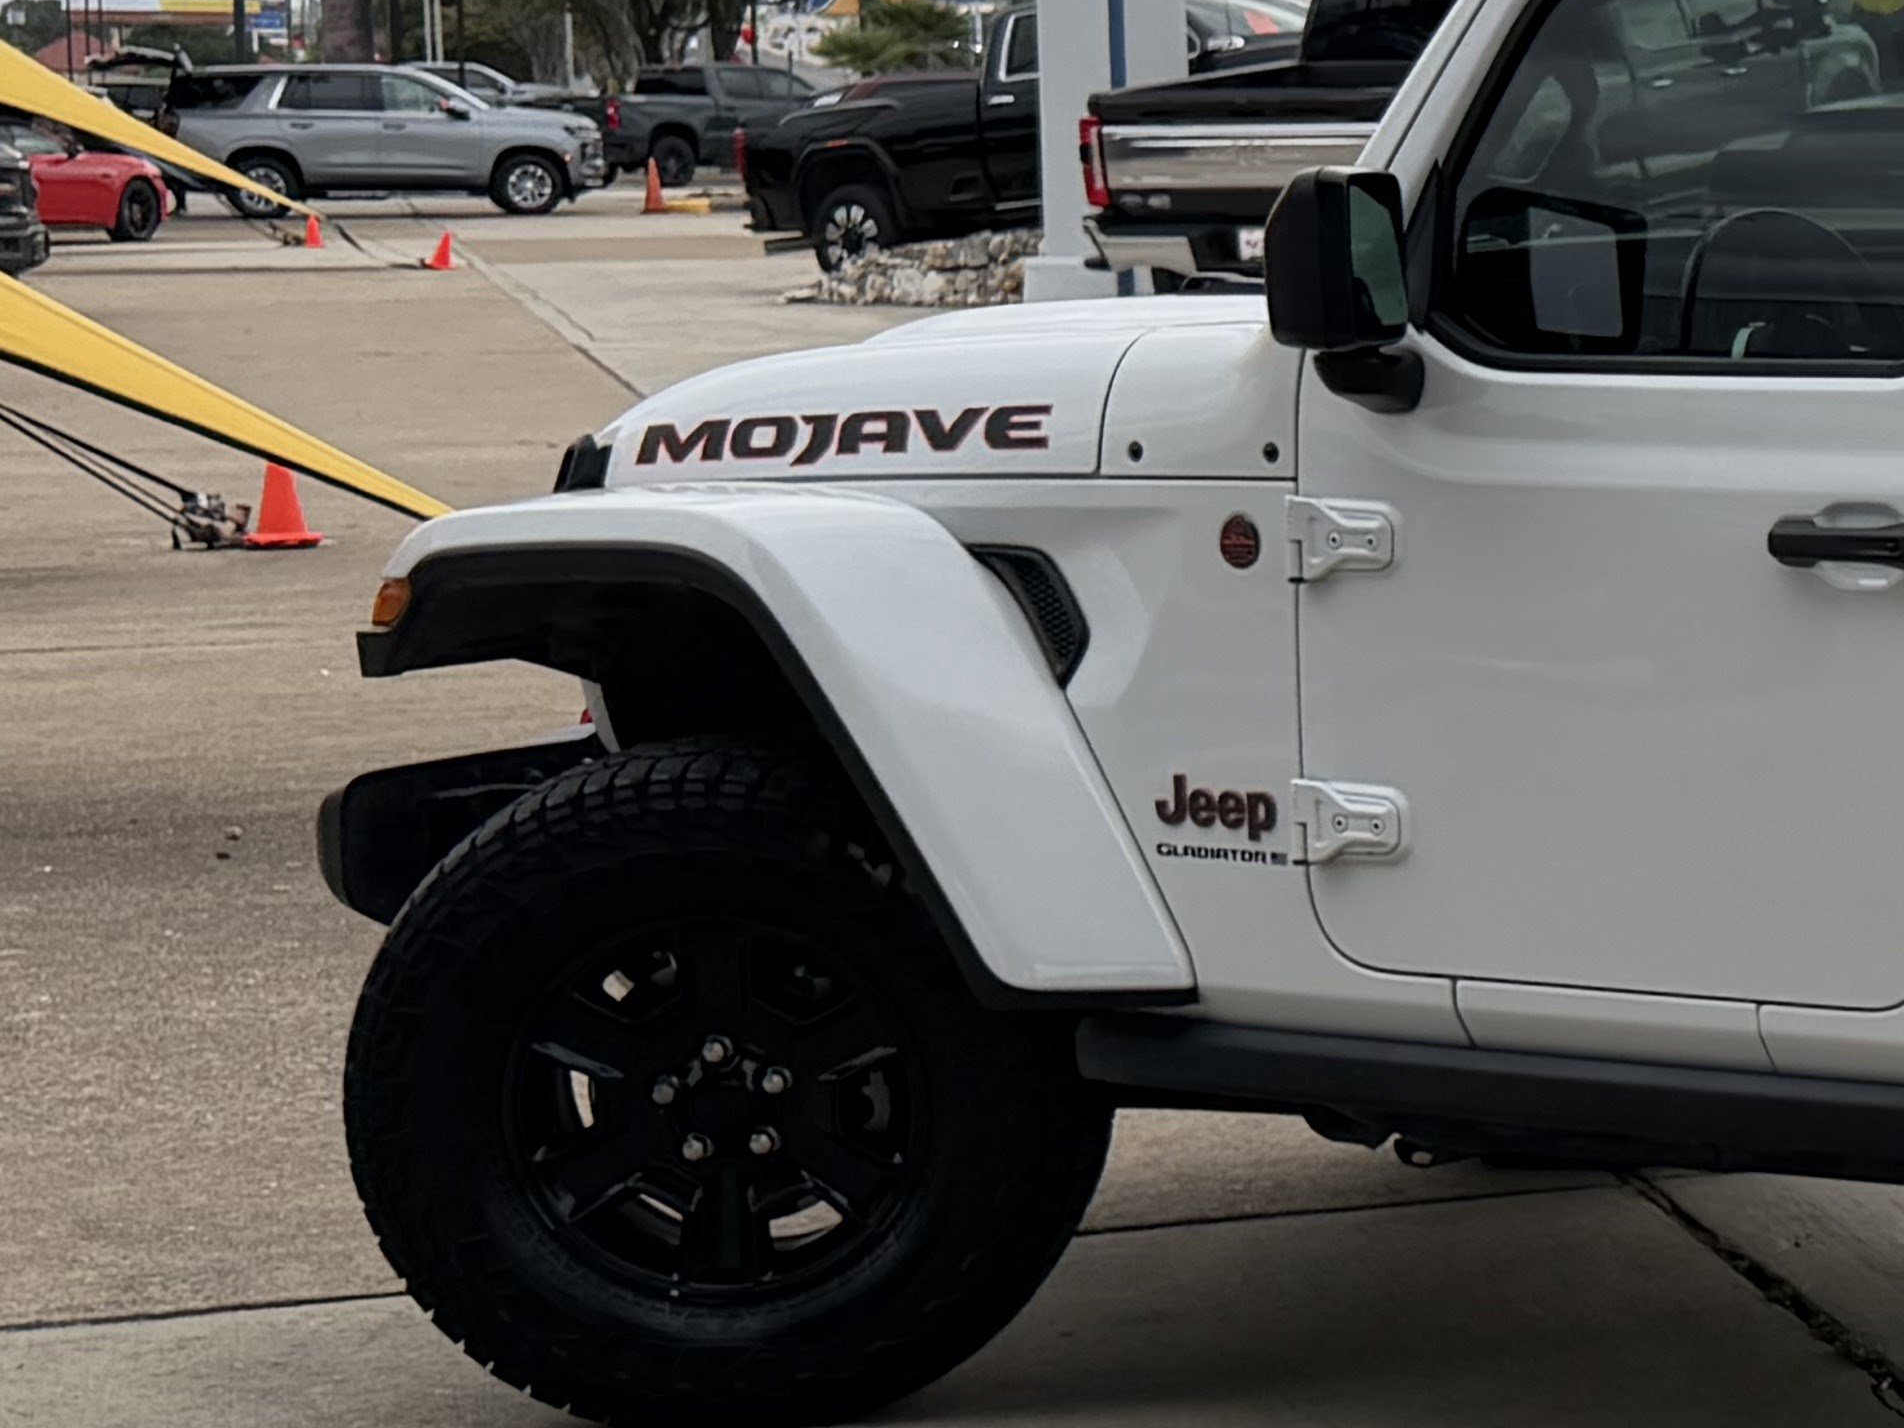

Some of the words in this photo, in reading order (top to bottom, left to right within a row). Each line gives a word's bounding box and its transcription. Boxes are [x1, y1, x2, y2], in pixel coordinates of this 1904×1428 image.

[635, 404, 1053, 467] MOJAVE
[1155, 774, 1277, 842] Jeep
[1156, 843, 1267, 865] GLADIATOR
